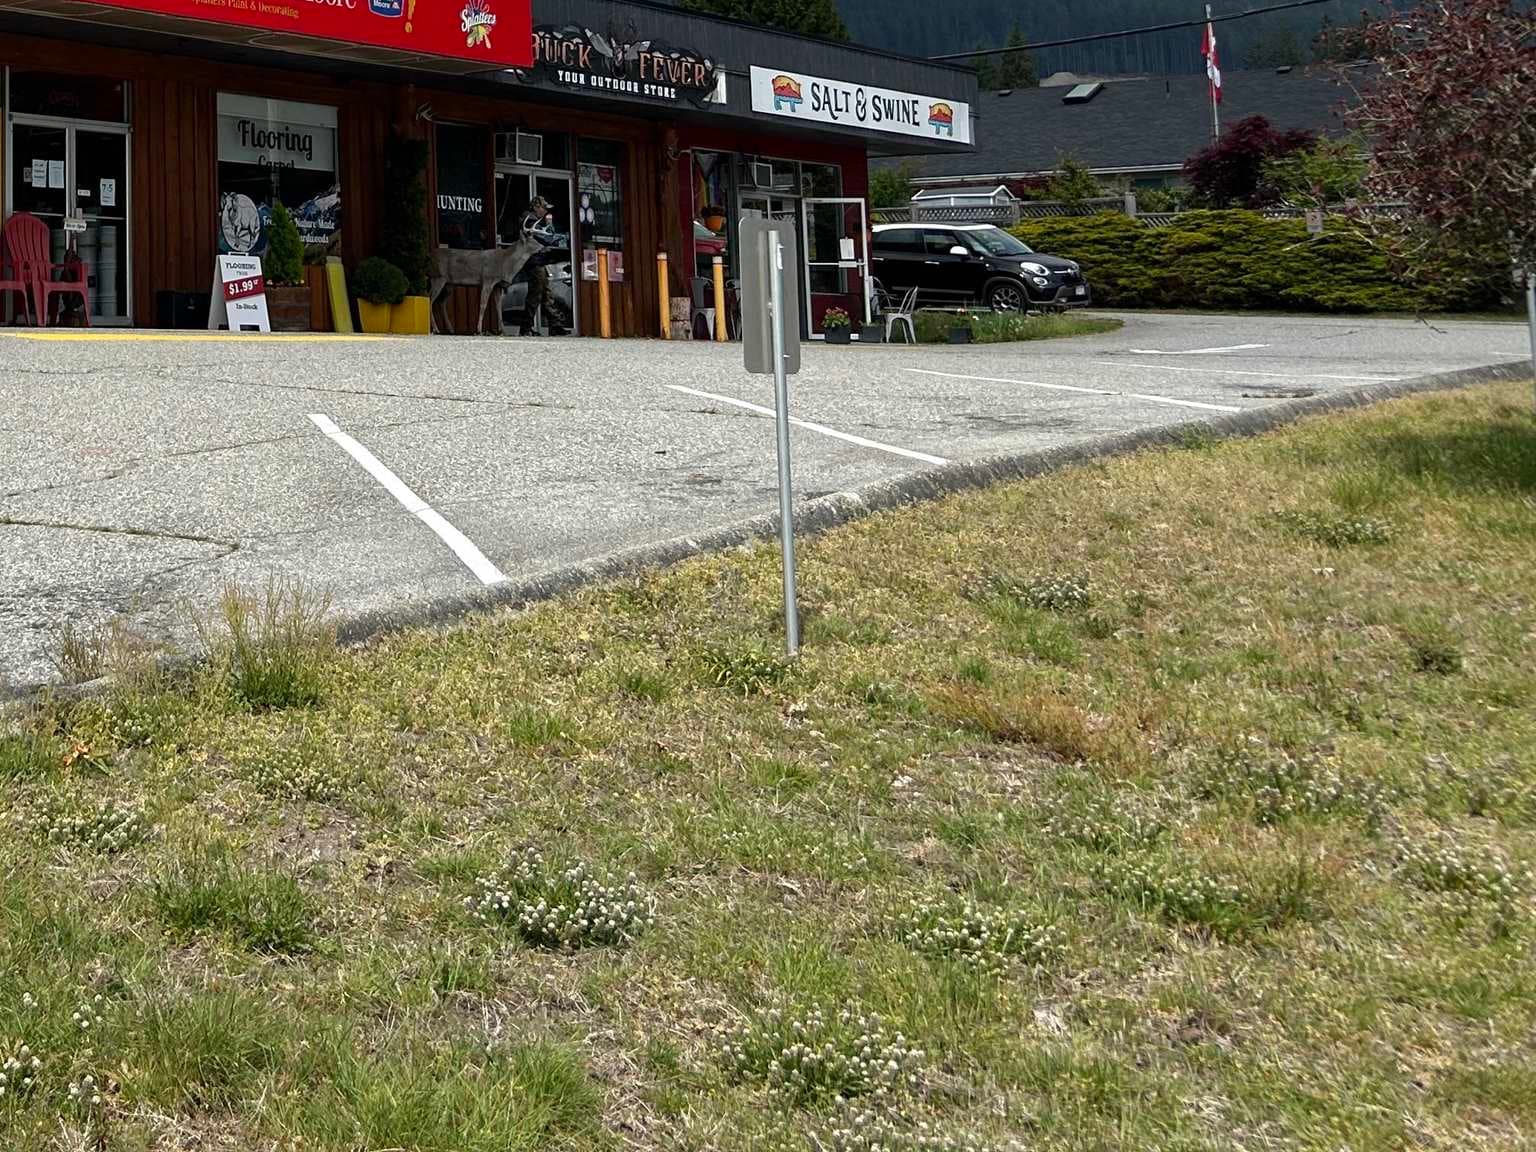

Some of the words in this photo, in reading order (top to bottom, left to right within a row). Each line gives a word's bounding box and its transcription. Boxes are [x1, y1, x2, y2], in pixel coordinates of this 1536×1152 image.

[250, 0, 257, 11] &
[258, 2, 300, 19] Decorating
[461, 8, 496, 33] Splatters
[639, 52, 706, 87] FEVER
[558, 70, 585, 85] YOUR
[591, 77, 639, 93] OUTDOOR
[644, 84, 676, 99] STORE
[811, 82, 852, 120] SALT
[855, 87, 867, 122] &
[872, 95, 920, 127] SWINE
[237, 119, 313, 161] Flooring
[229, 279, 253, 295] $1.99
